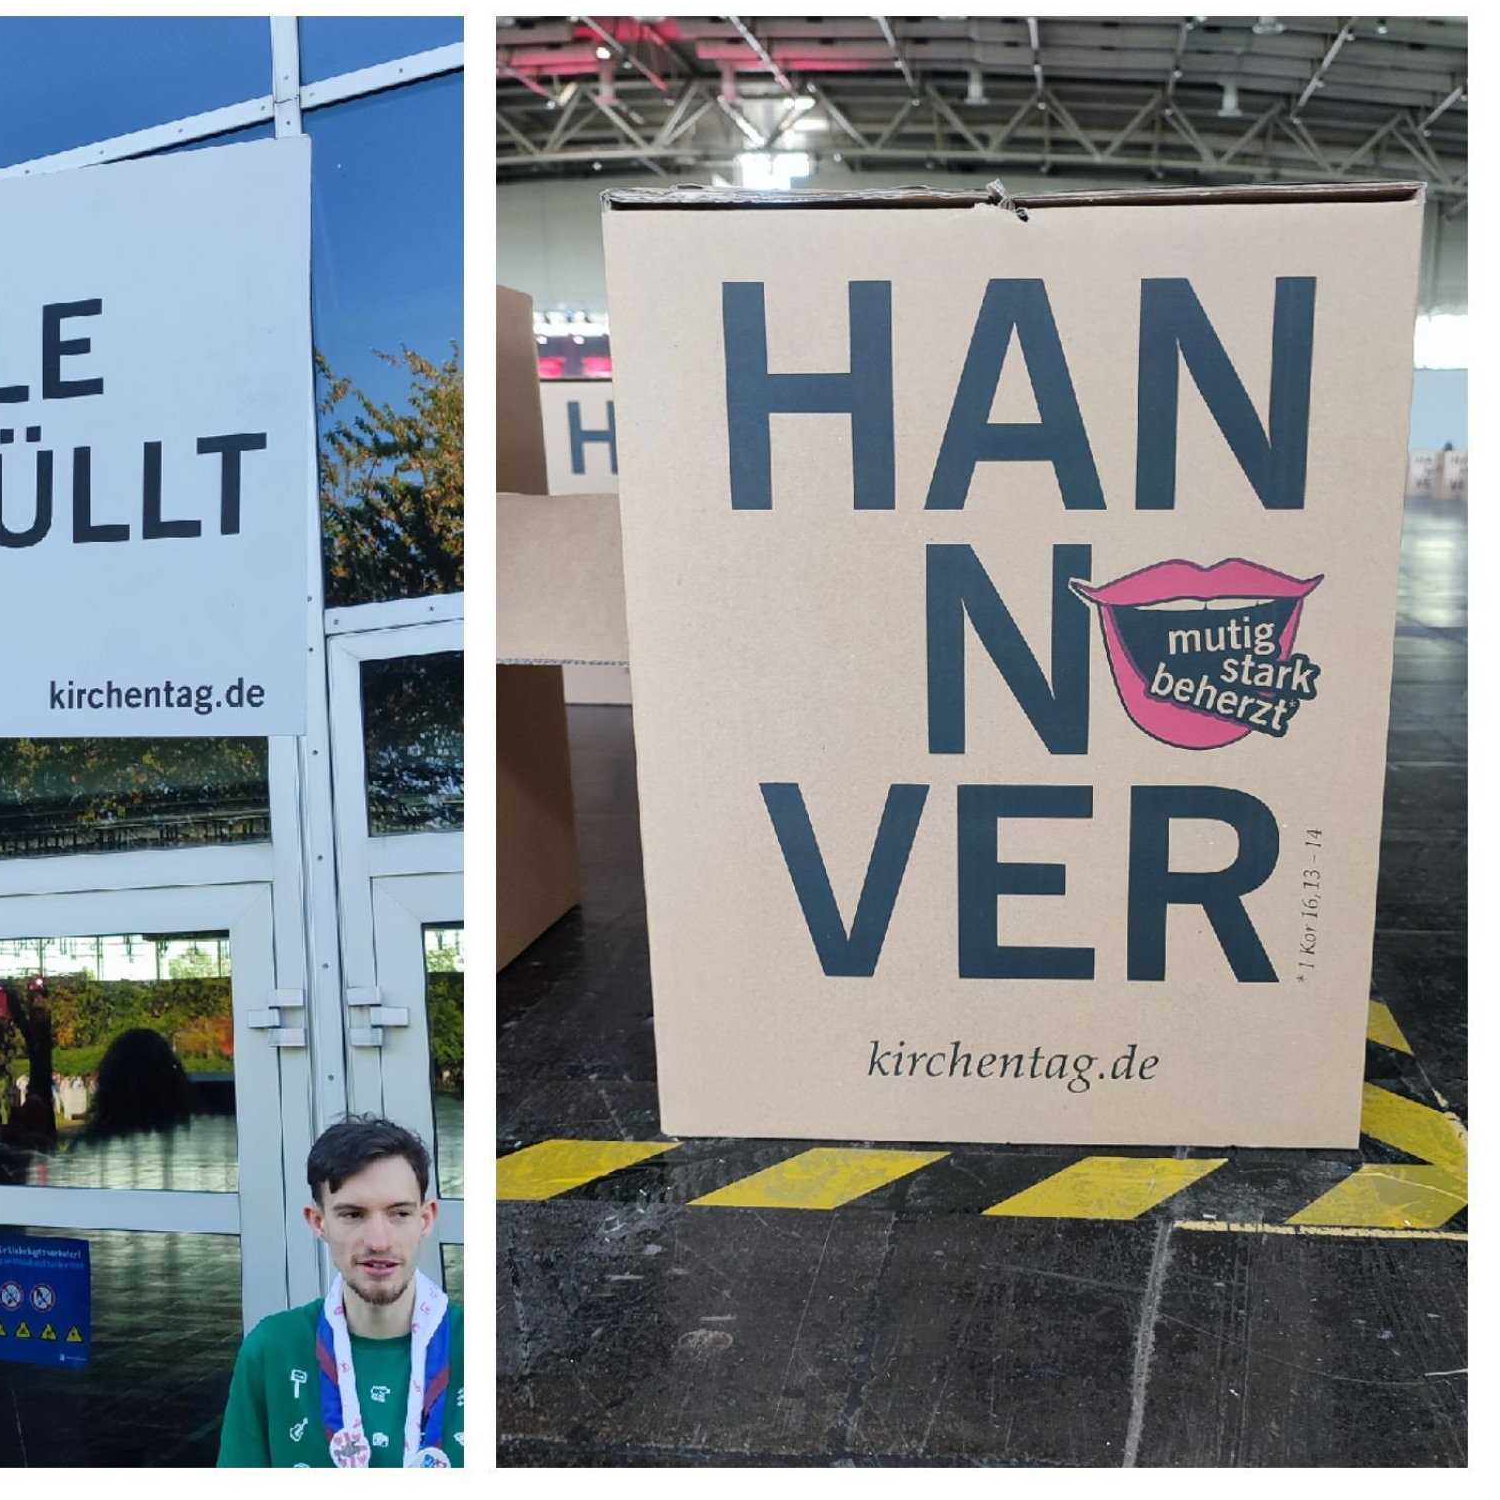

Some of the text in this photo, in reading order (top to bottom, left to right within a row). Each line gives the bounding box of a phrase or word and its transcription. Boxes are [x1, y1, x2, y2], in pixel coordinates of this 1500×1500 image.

[722, 276, 1317, 511] HAN
[1168, 616, 1276, 656] mutig
[1220, 654, 1314, 693] stark
[48, 677, 266, 717] kirchentag.de
[757, 781, 1281, 984] VER
[1299, 924, 1317, 955] Kor
[866, 1040, 1160, 1094] kirchentag.de
